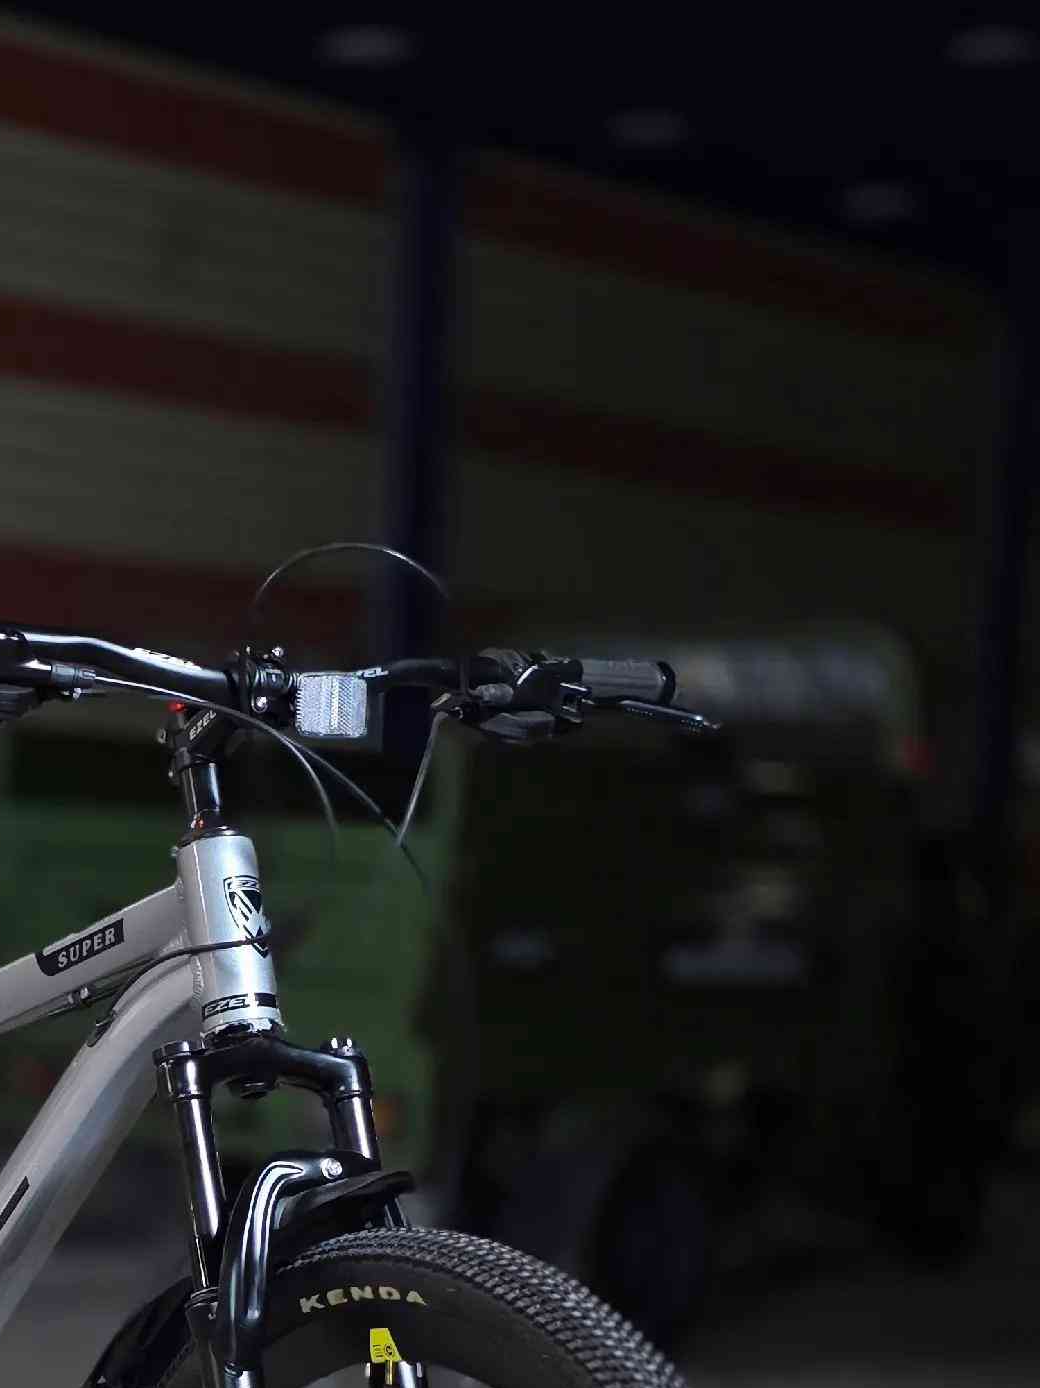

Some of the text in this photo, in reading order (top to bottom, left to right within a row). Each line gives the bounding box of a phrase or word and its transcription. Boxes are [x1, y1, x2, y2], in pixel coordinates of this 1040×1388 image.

[189, 710, 217, 740] EZEL
[57, 927, 116, 968] SUPER
[299, 1286, 428, 1313] KENDA
